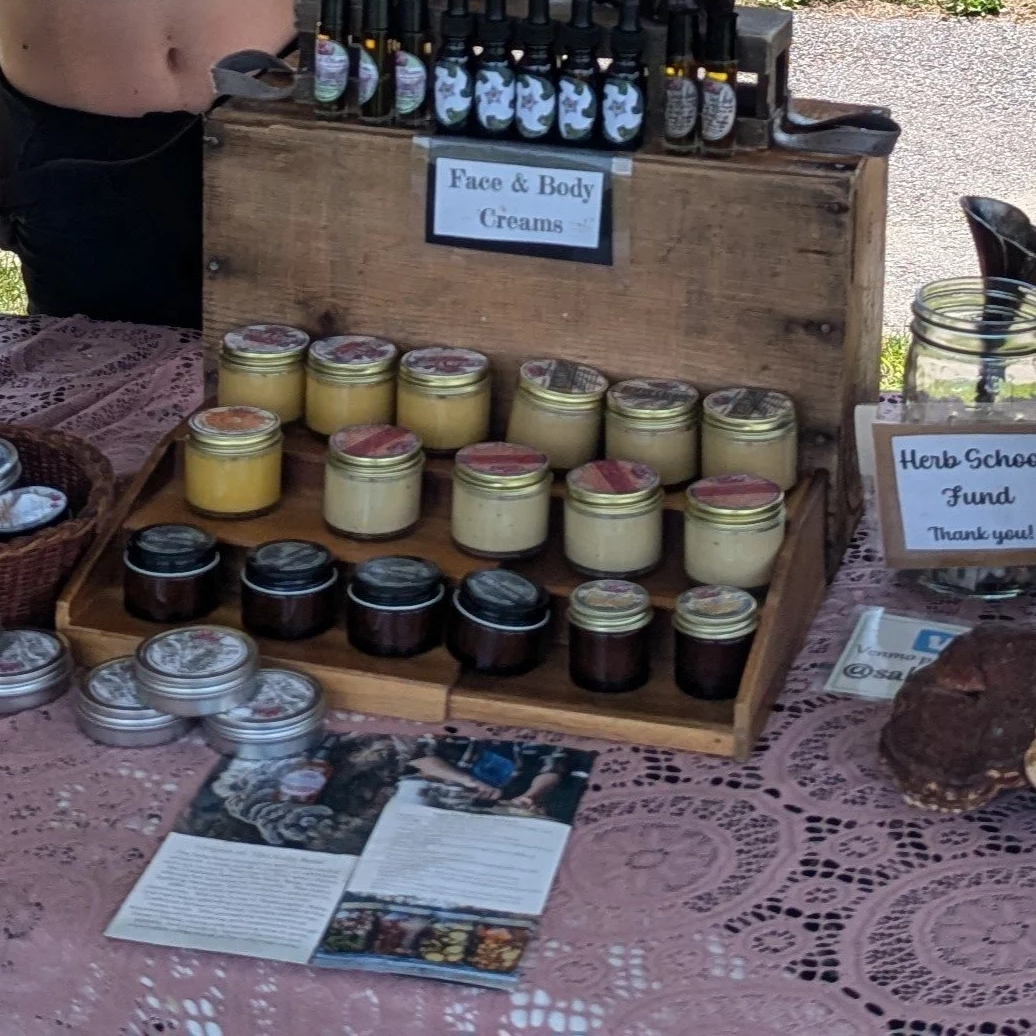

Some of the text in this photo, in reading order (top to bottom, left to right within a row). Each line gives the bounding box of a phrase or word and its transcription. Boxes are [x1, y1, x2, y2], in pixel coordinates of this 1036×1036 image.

[449, 167, 595, 204] Face & Body
[479, 207, 564, 234] Creams
[899, 447, 1036, 470] Herb Schoo
[941, 484, 1016, 507] Fund
[927, 524, 1035, 545] Thank you!
[856, 644, 917, 661] Venmo
[842, 663, 915, 682] @sa
